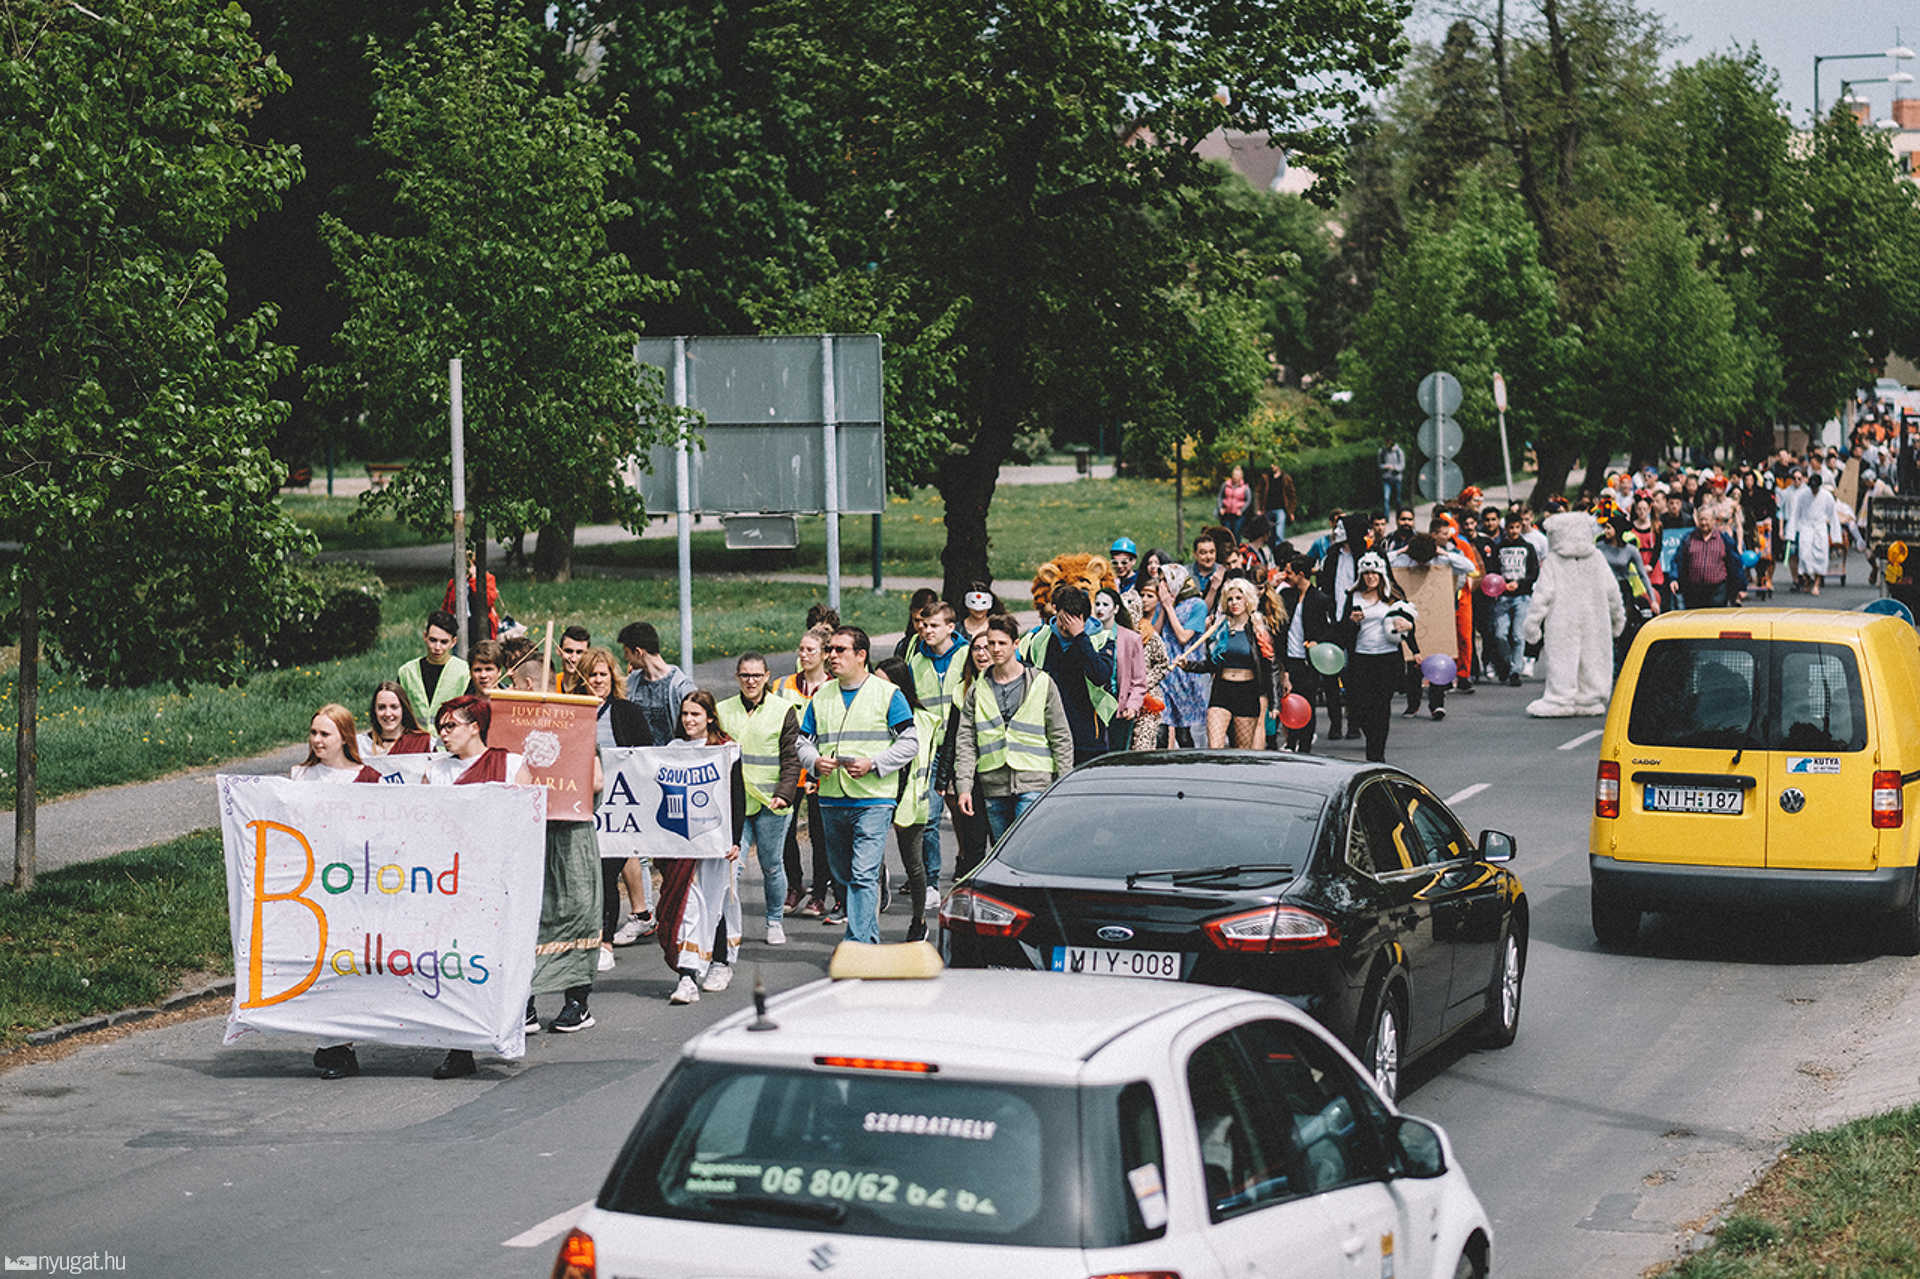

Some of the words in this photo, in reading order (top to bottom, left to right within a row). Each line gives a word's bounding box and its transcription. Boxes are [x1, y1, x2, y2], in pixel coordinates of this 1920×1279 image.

[511, 705, 576, 720] JUVENTUS
[658, 764, 719, 785] SAVARIA
[1070, 948, 1174, 976] MIY-008
[863, 1112, 997, 1140] SZOMBATHELY
[761, 1165, 804, 1195] 06
[808, 1168, 900, 1203] 80/62
